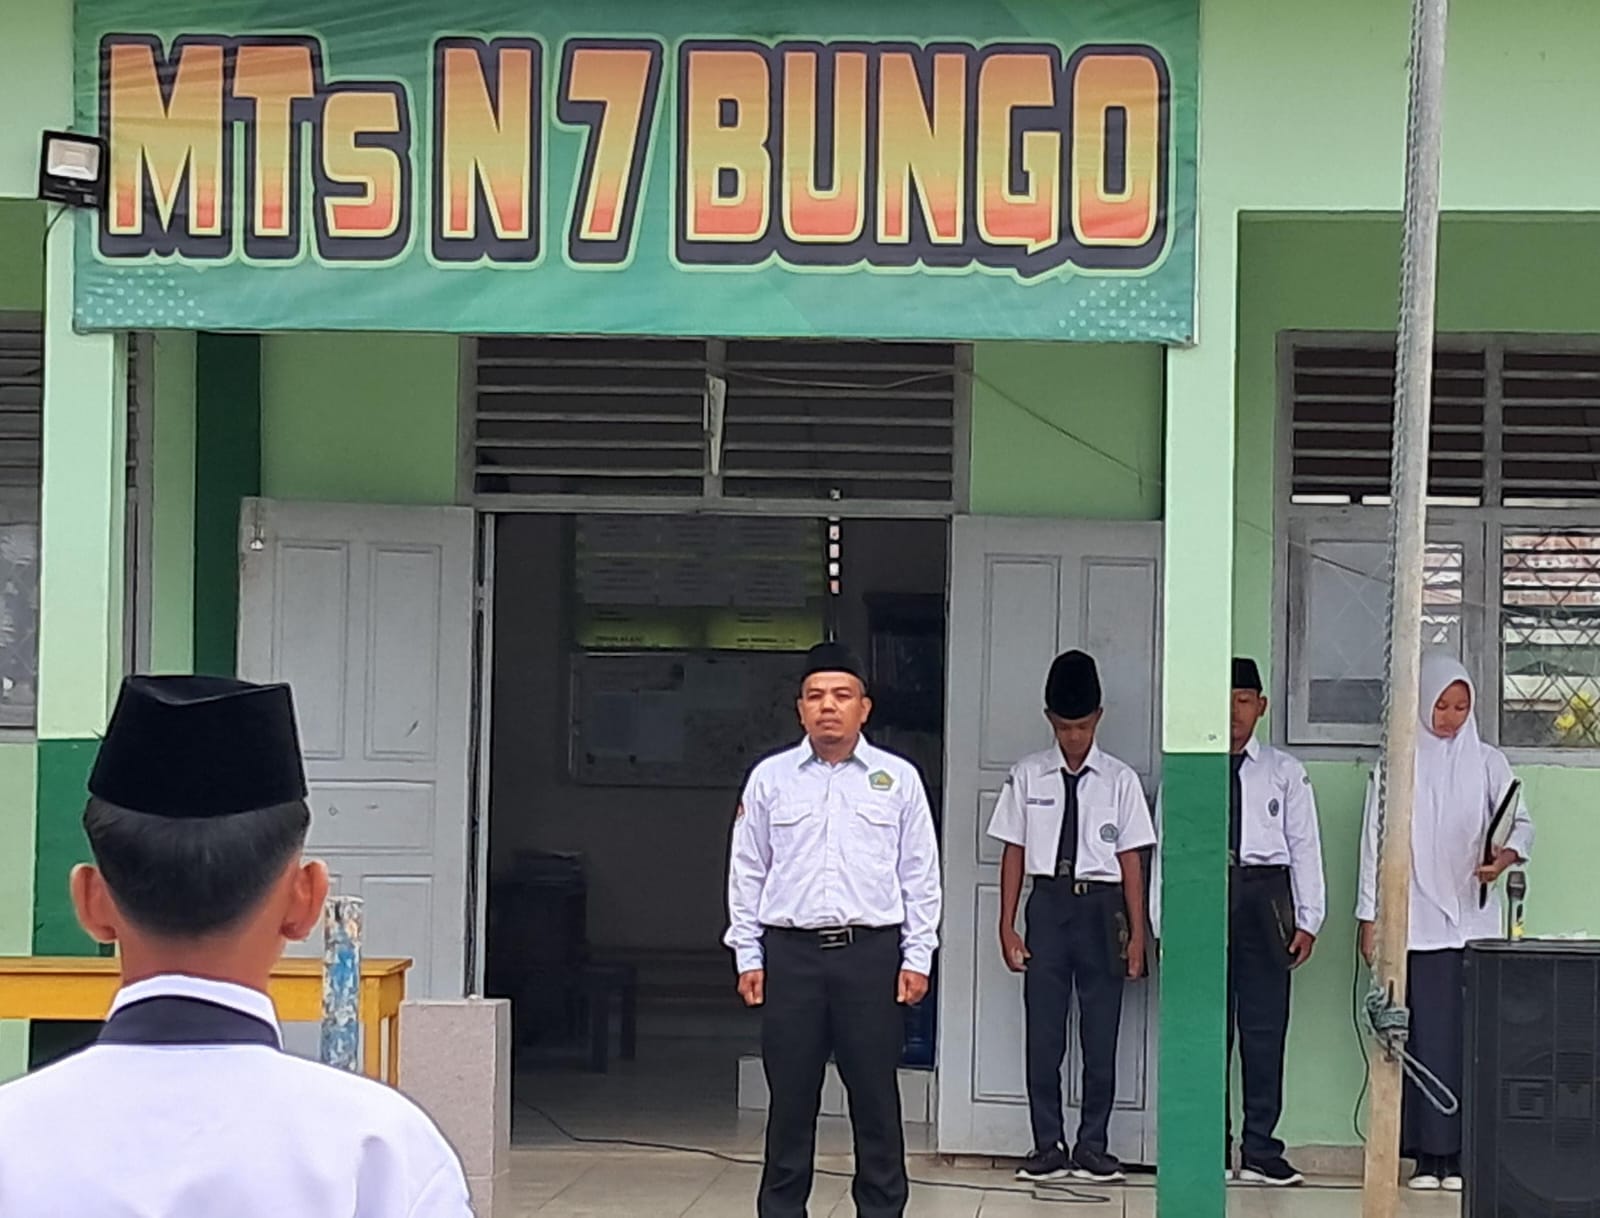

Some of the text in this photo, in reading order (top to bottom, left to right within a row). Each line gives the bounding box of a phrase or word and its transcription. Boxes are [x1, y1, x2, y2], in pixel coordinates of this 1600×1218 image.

[107, 43, 1161, 254] MTs N 7 BUNGO
